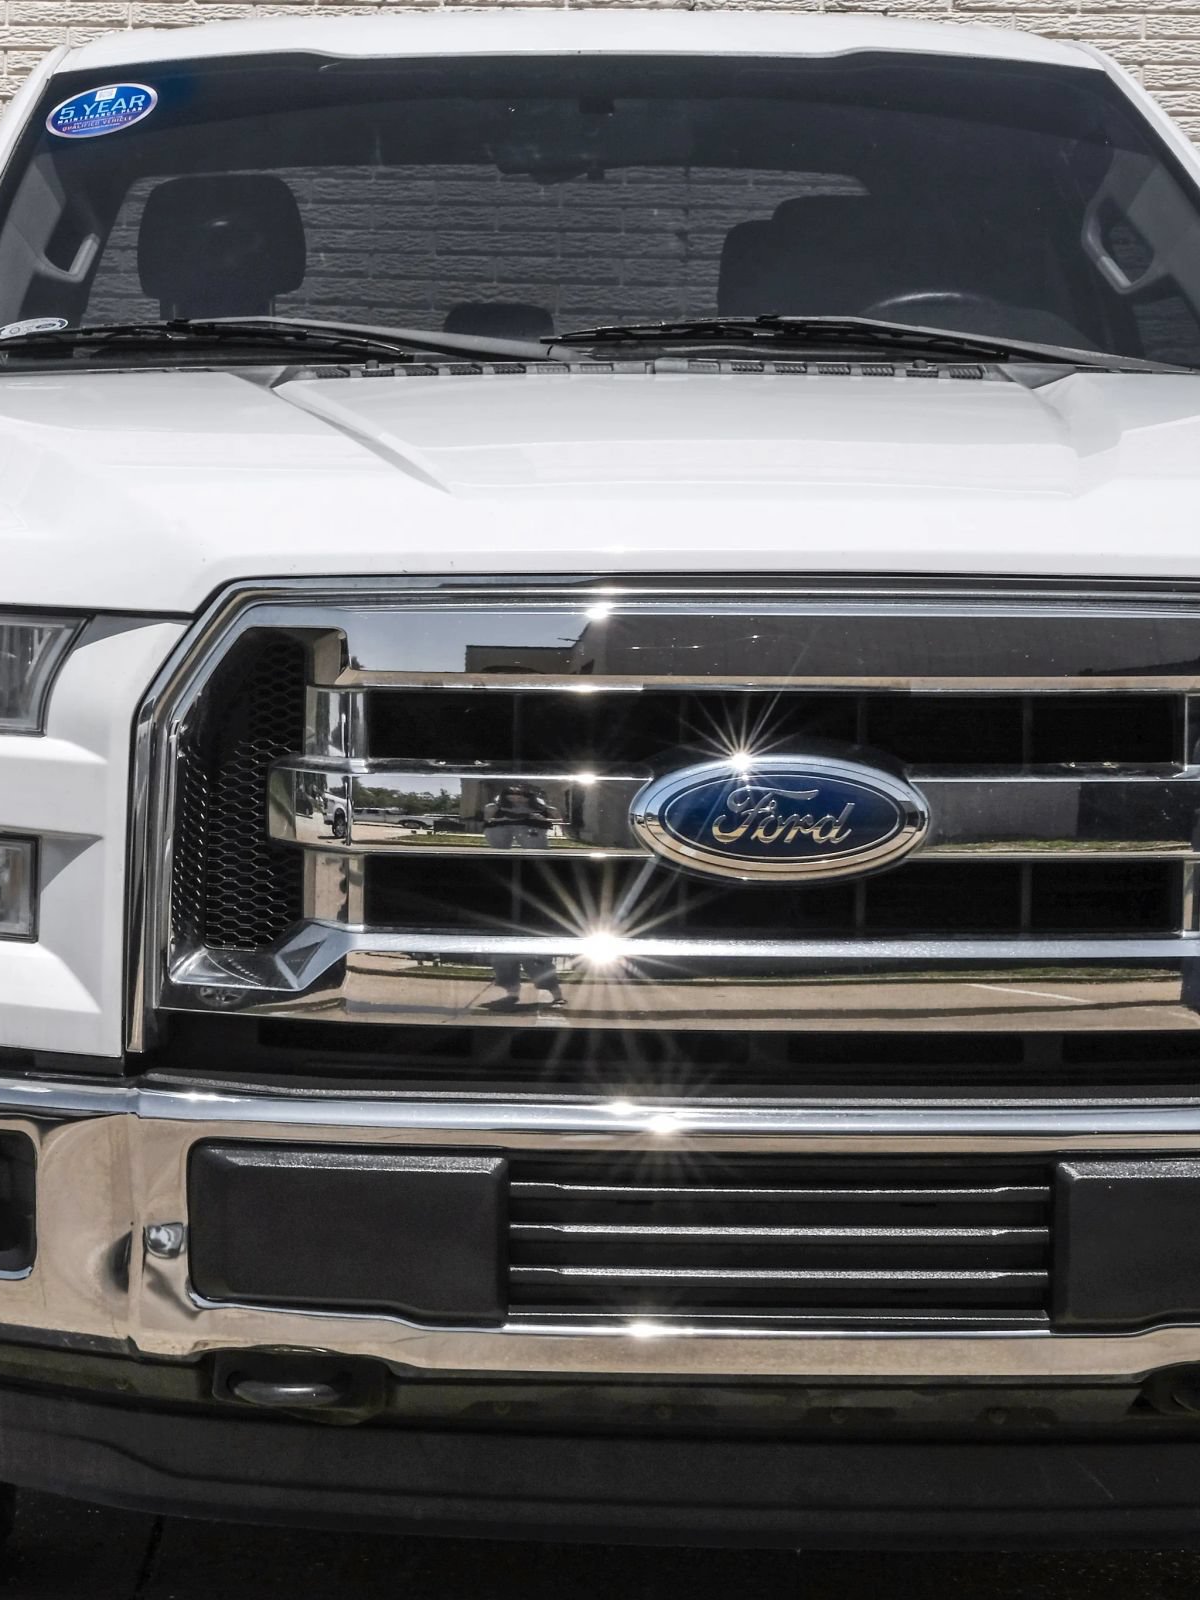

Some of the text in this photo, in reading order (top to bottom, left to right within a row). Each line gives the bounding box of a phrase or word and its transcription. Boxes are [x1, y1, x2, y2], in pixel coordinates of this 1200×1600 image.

[59, 94, 145, 120] 5 YEAR
[712, 785, 855, 844] Ford
